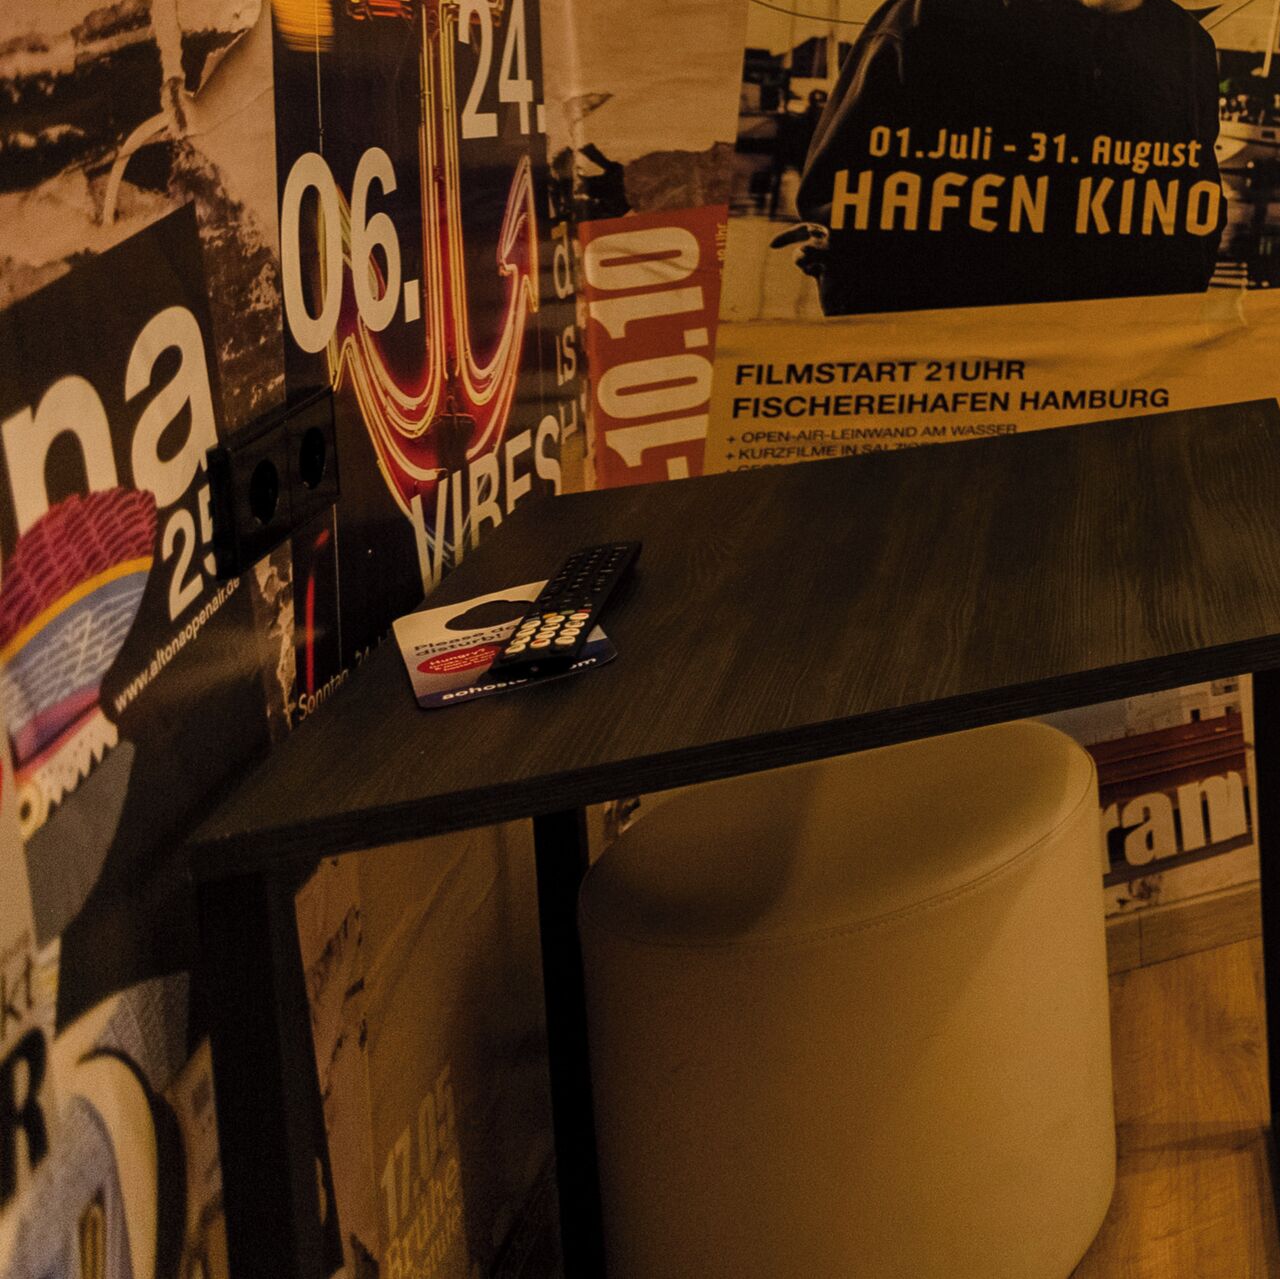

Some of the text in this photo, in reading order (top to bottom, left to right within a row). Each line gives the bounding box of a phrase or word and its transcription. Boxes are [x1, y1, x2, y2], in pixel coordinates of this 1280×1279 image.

[1028, 130, 1081, 165] 31.
[1091, 134, 1202, 175] August
[830, 168, 1223, 238] HAFEN KINO
[281, 146, 421, 354] 06.
[735, 359, 1025, 387] FILMSTART 21UHR
[732, 388, 1170, 419] FISCHEREIHAFEN HAMBURG
[740, 426, 918, 444] OPEN-AIR-LEINWAND
[921, 424, 946, 437] AM
[738, 445, 836, 461] KURZFILME
[840, 444, 857, 457] IN
